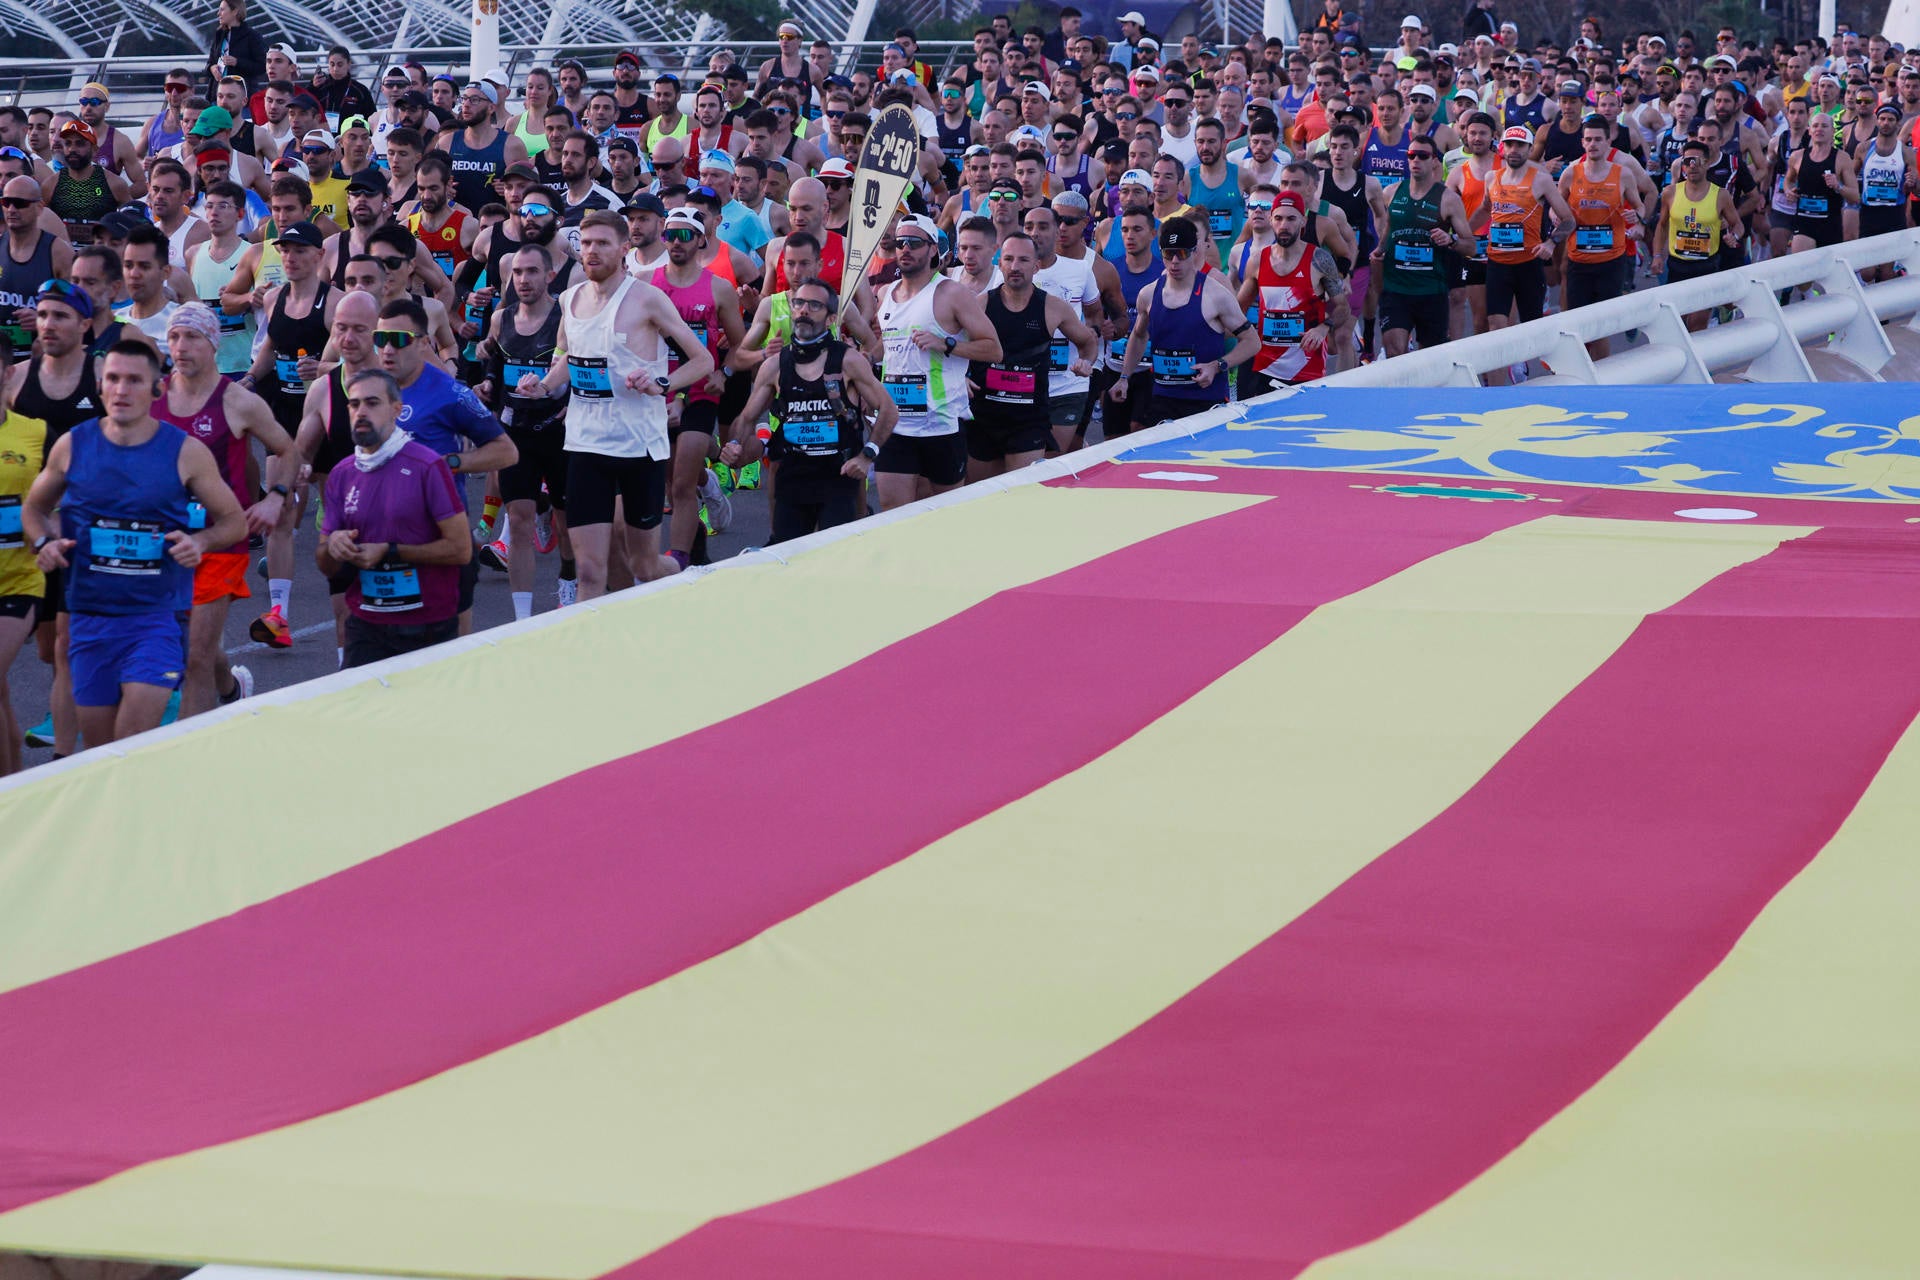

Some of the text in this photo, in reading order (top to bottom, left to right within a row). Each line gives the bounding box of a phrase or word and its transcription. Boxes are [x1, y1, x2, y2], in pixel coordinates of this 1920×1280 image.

[1506, 127, 1526, 137] ciele
[878, 131, 913, 173] 2h50
[452, 160, 494, 172] REDOLAT
[1371, 157, 1405, 170] FRANCE
[576, 369, 593, 380] 2761
[893, 386, 909, 395] 1131
[800, 425, 820, 434] 2842
[797, 435, 825, 443] Eduardo
[113, 533, 140, 546] 3161
